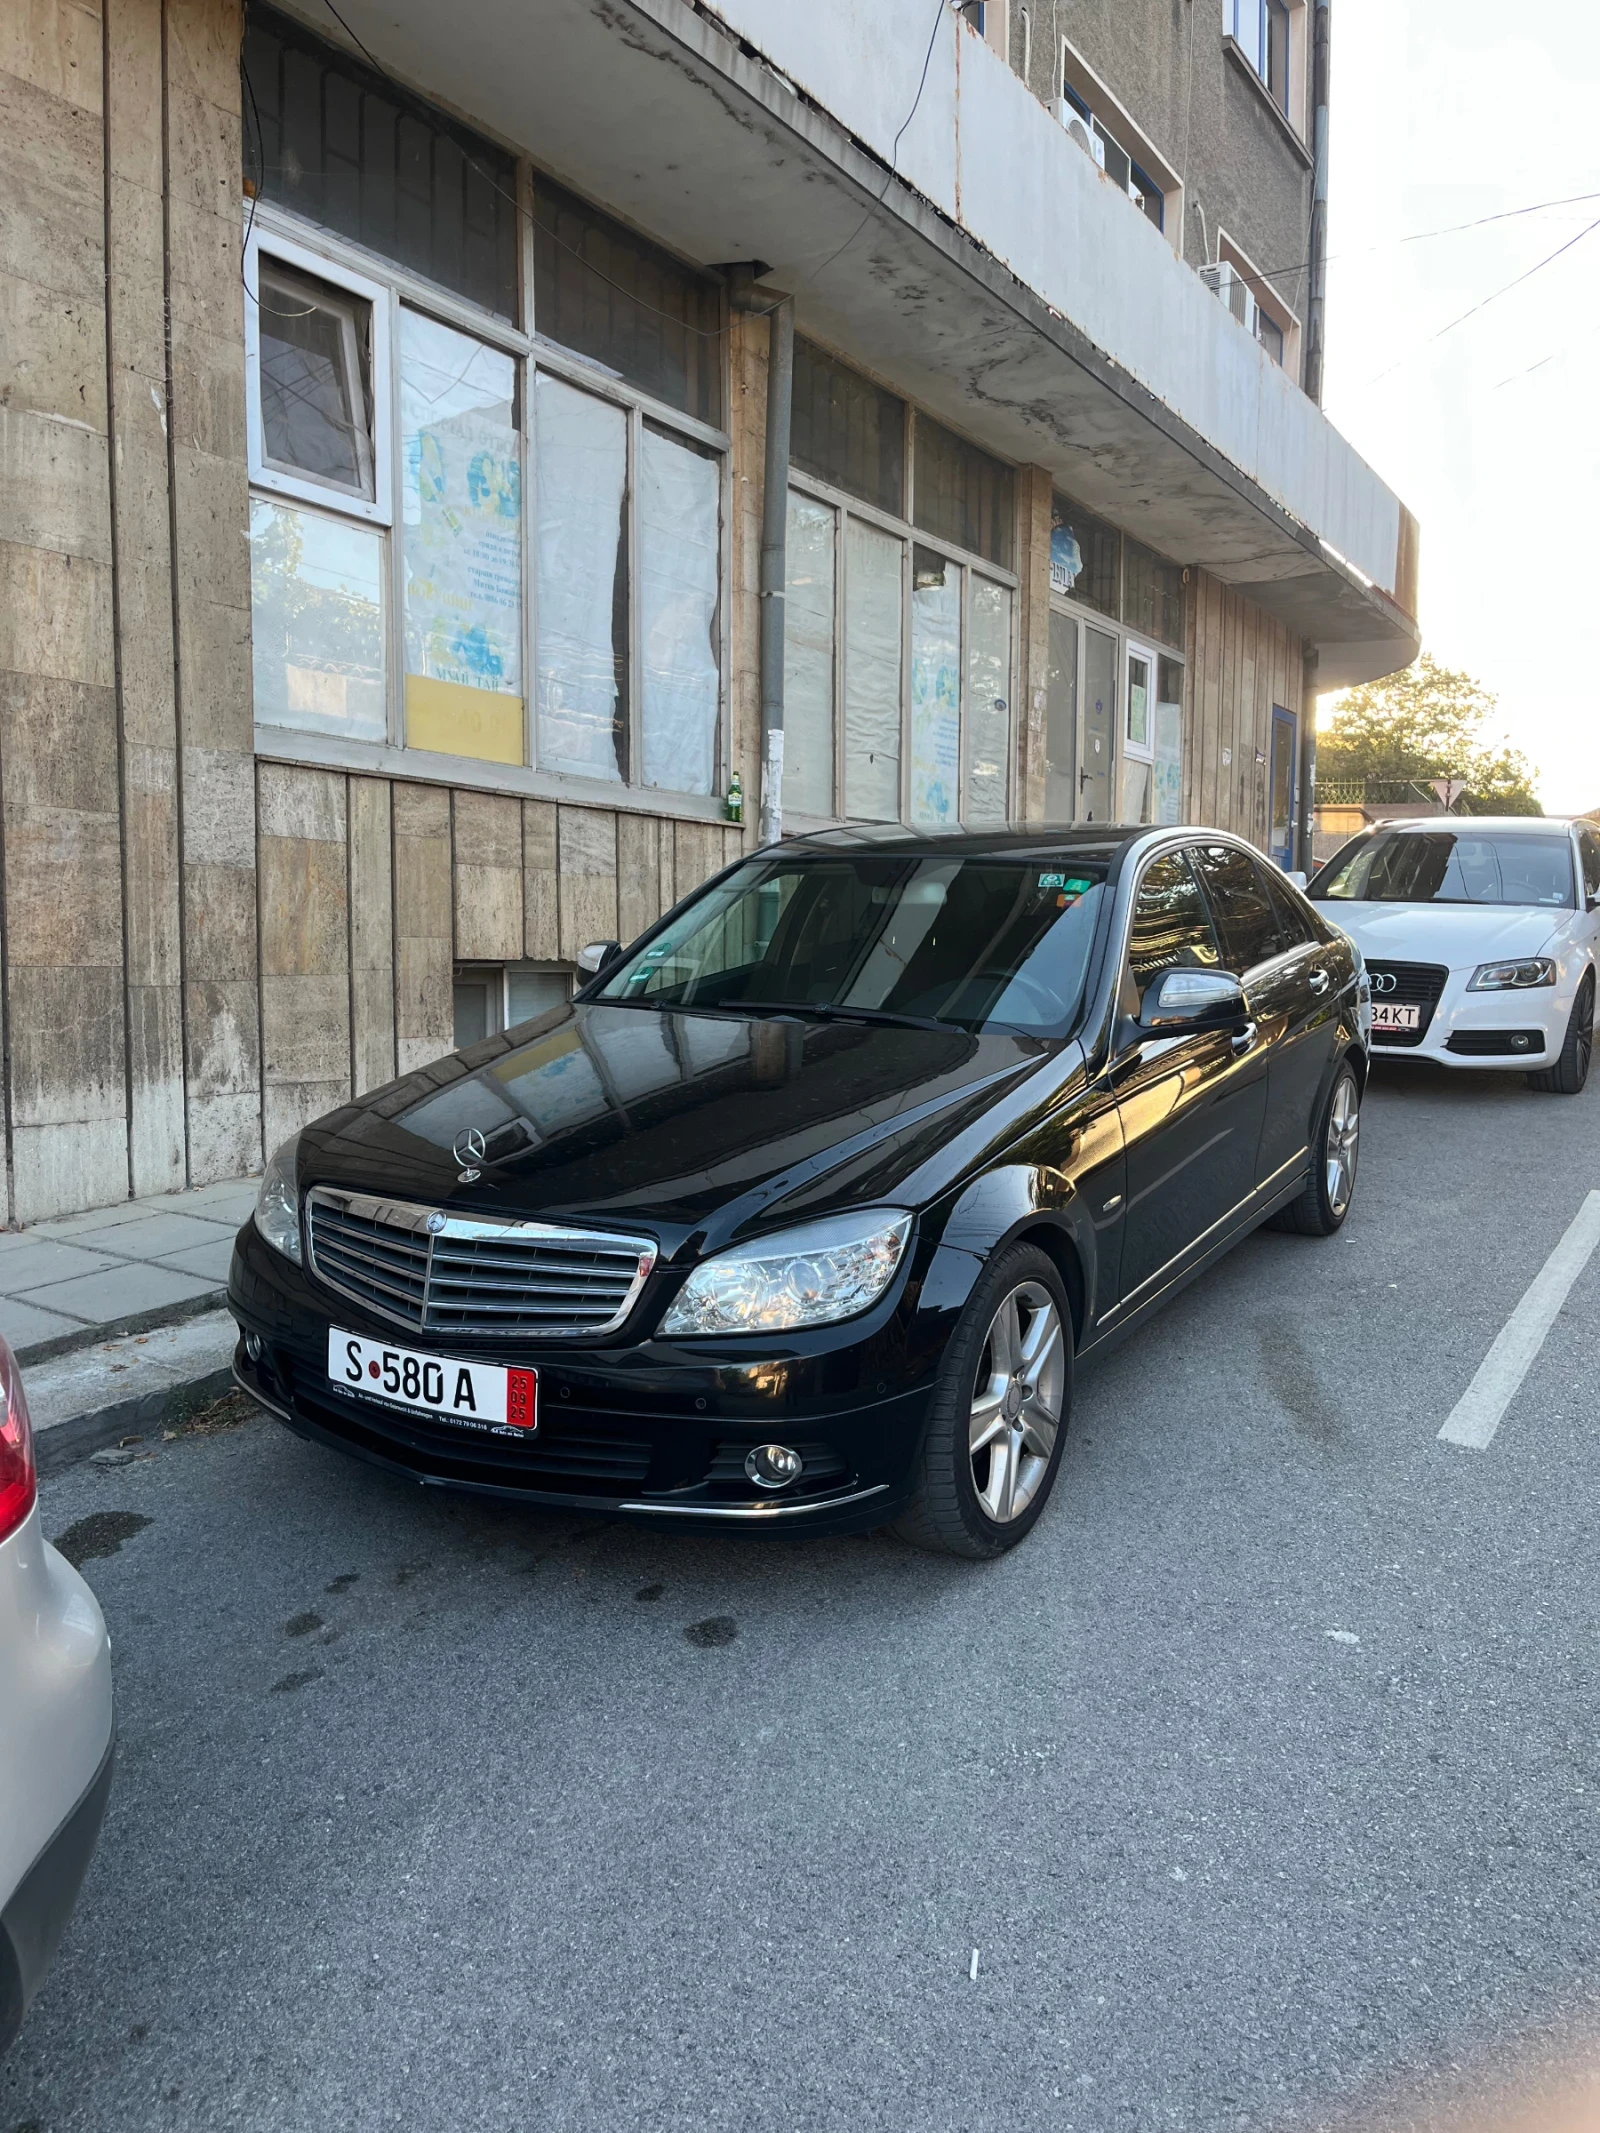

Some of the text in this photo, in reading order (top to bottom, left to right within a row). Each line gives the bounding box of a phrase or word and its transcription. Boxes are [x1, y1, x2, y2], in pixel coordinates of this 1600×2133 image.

[345, 1340, 477, 1411] S 580 A
[511, 1375, 527, 1390] 25
[510, 1390, 526, 1405] 09
[510, 1405, 526, 1420] 25
